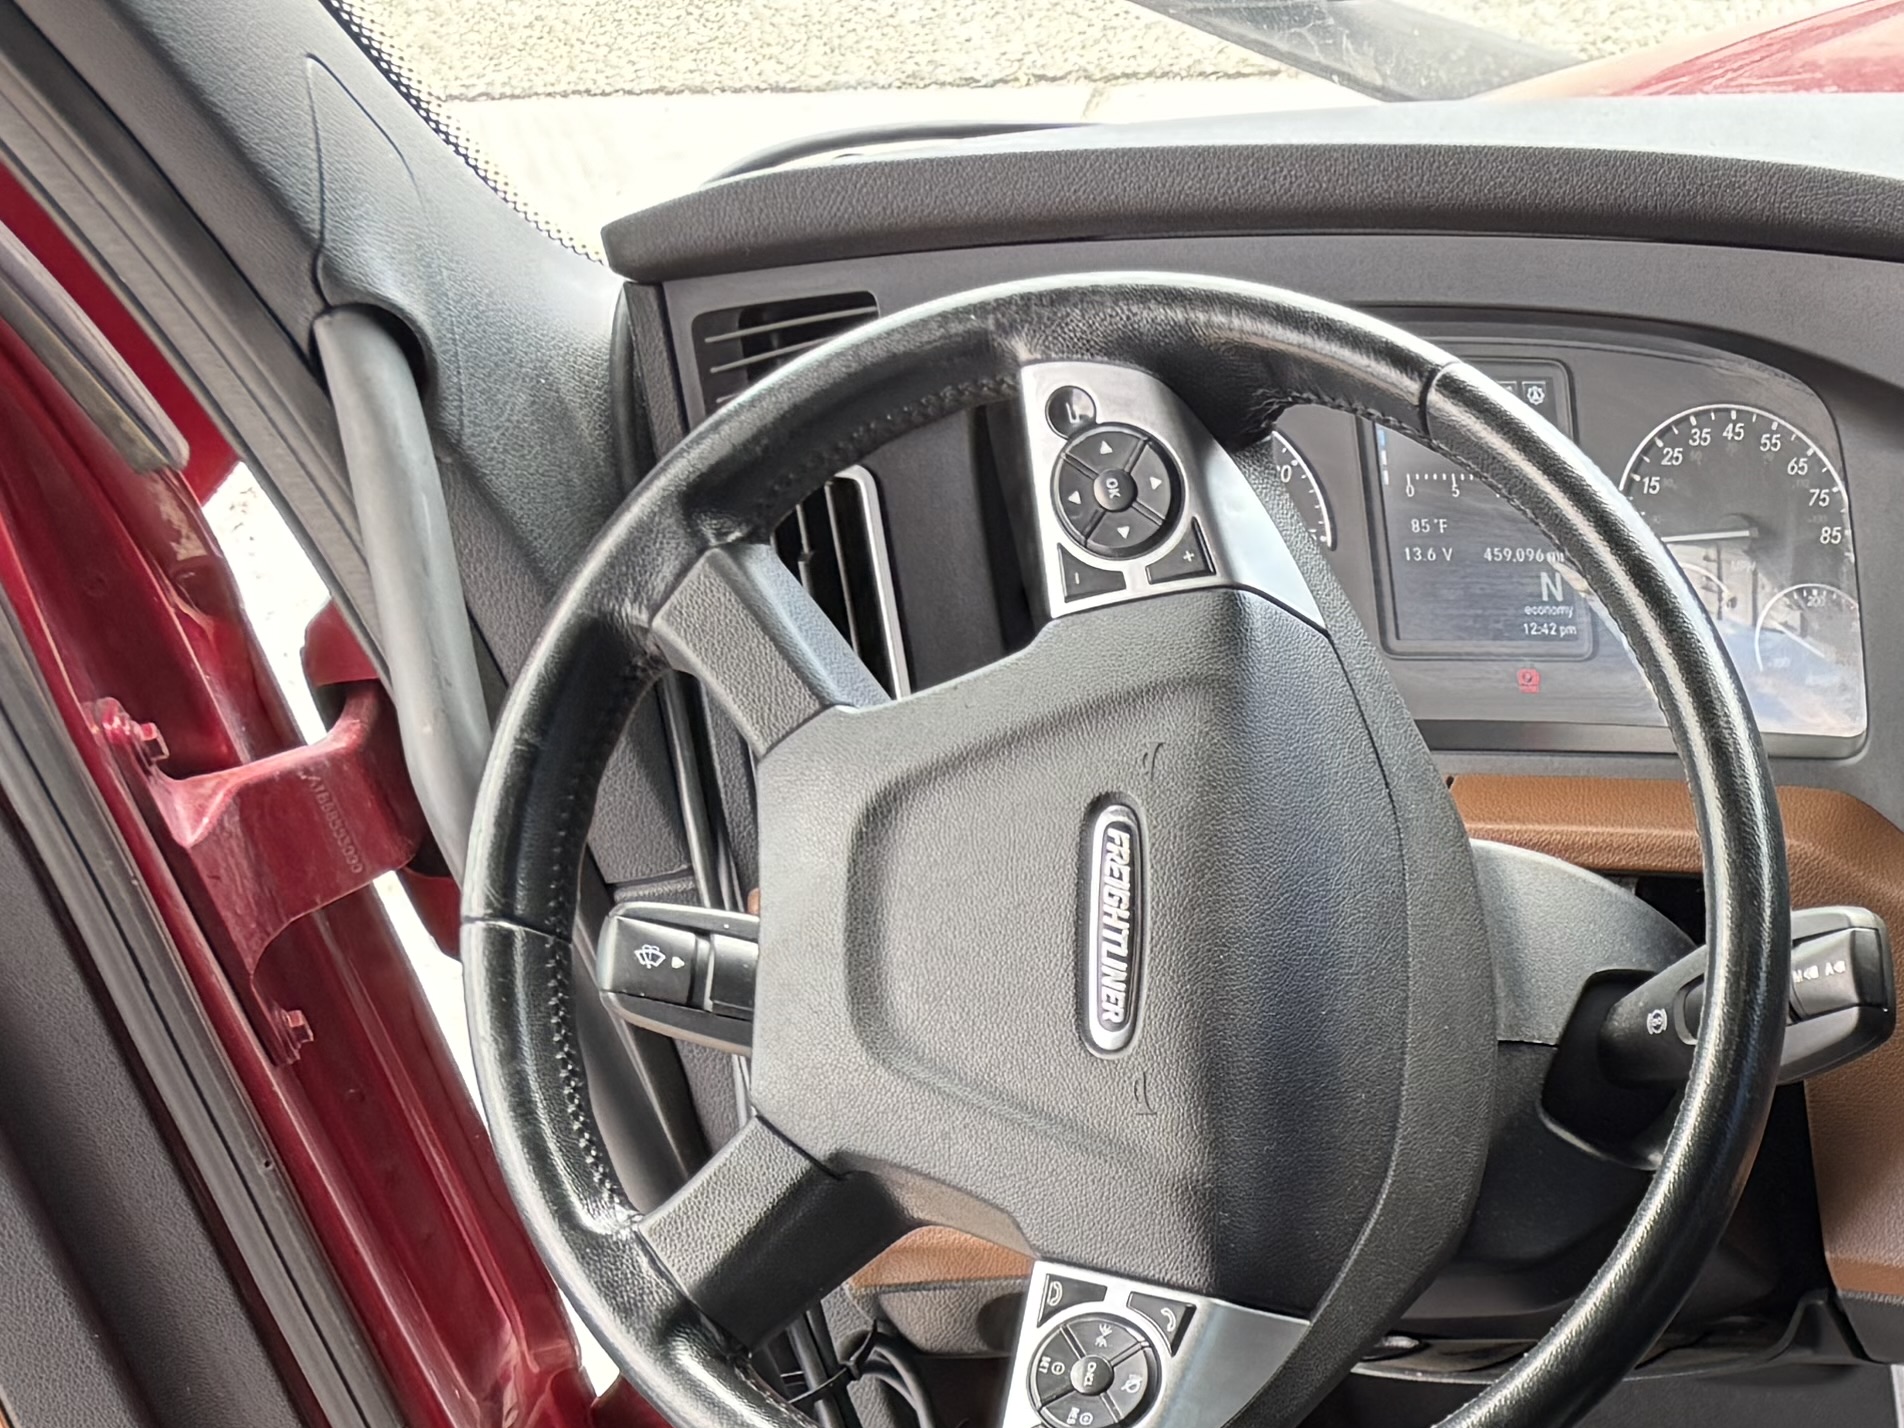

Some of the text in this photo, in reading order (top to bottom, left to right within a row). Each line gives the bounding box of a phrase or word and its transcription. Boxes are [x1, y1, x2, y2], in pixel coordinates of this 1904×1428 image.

[1688, 428, 1711, 446] 35
[1723, 423, 1745, 441] 45
[1759, 434, 1781, 452] 55
[1661, 448, 1683, 466] 25
[1787, 458, 1808, 476] 65
[1106, 477, 1121, 499] OK
[1406, 485, 1415, 497] 0
[1452, 485, 1460, 498] 5
[1642, 476, 1660, 494] 15
[1808, 489, 1830, 507] 75
[1411, 519, 1430, 533] 85
[1820, 526, 1842, 544] 85
[1404, 547, 1453, 562] 13.6 V
[1540, 571, 1564, 602] N
[1524, 604, 1574, 618] economy
[1523, 622, 1577, 638] 12:42 pm
[1101, 826, 1131, 1024] FREIGHTLINER
